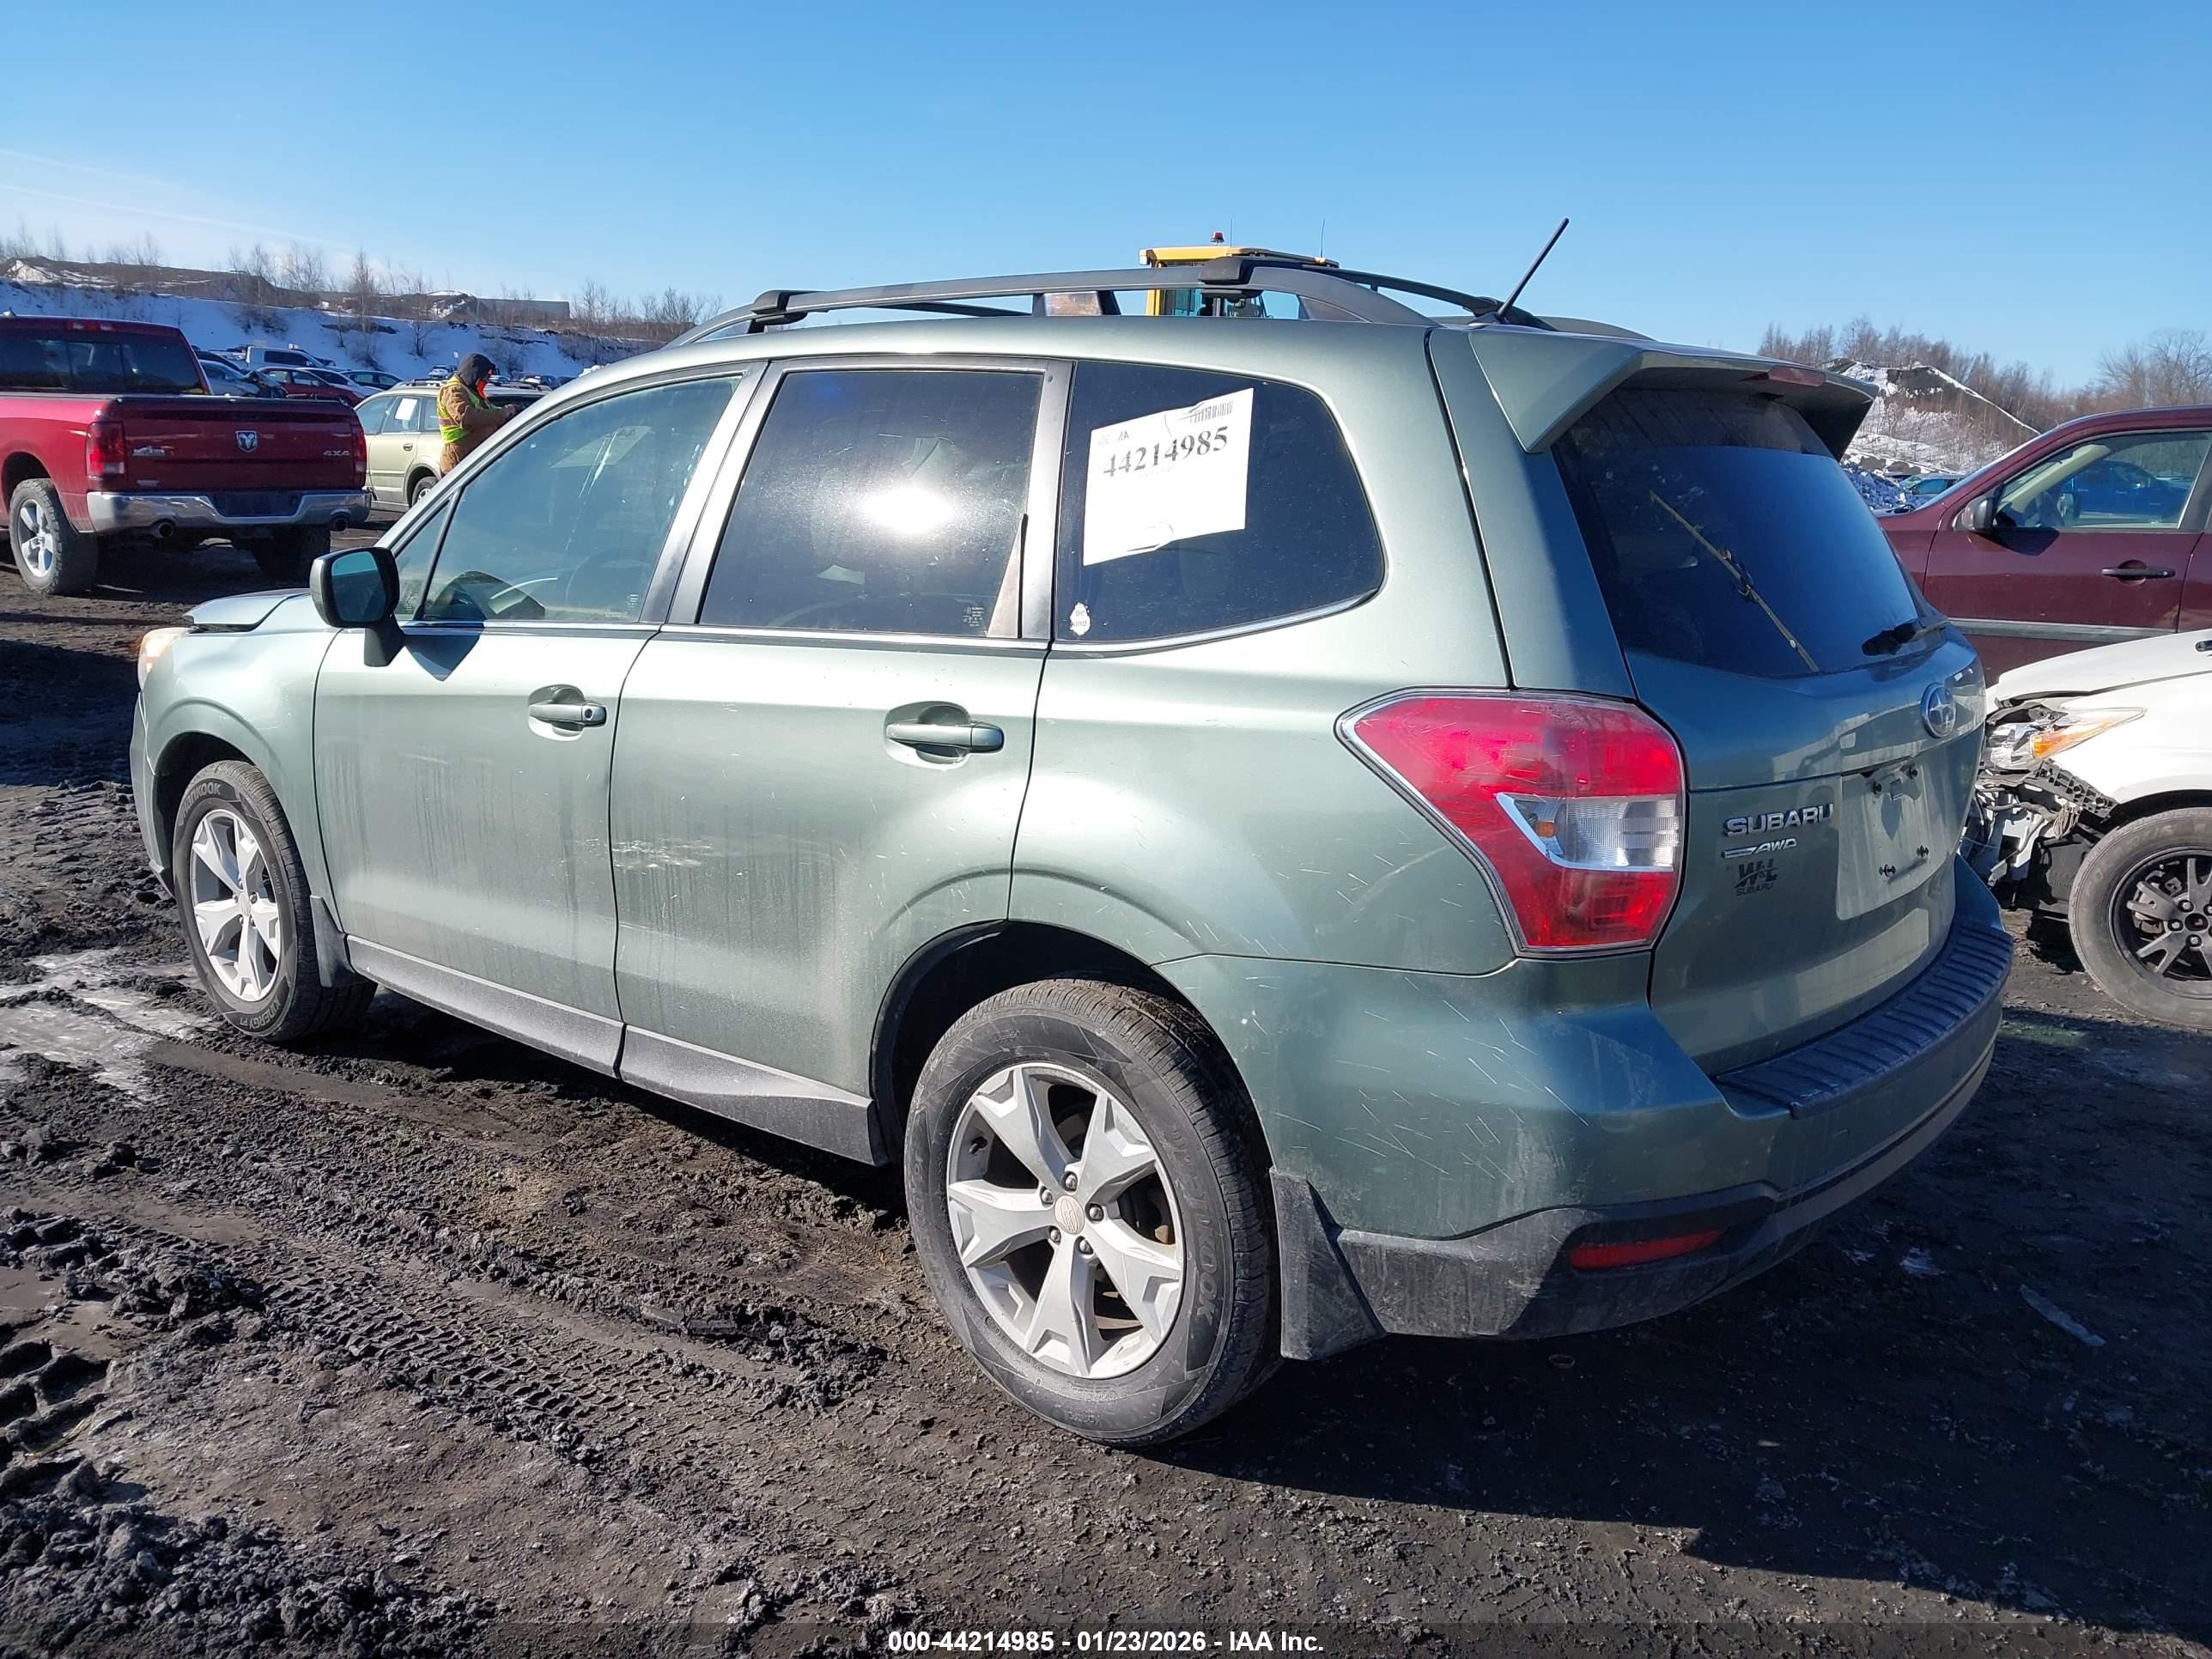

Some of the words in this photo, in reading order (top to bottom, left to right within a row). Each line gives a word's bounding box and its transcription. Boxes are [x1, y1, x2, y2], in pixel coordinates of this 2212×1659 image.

[1103, 426, 1228, 477] 44214985
[1725, 804, 1833, 837] SUBARU
[1736, 883, 1773, 896] SUBARU
